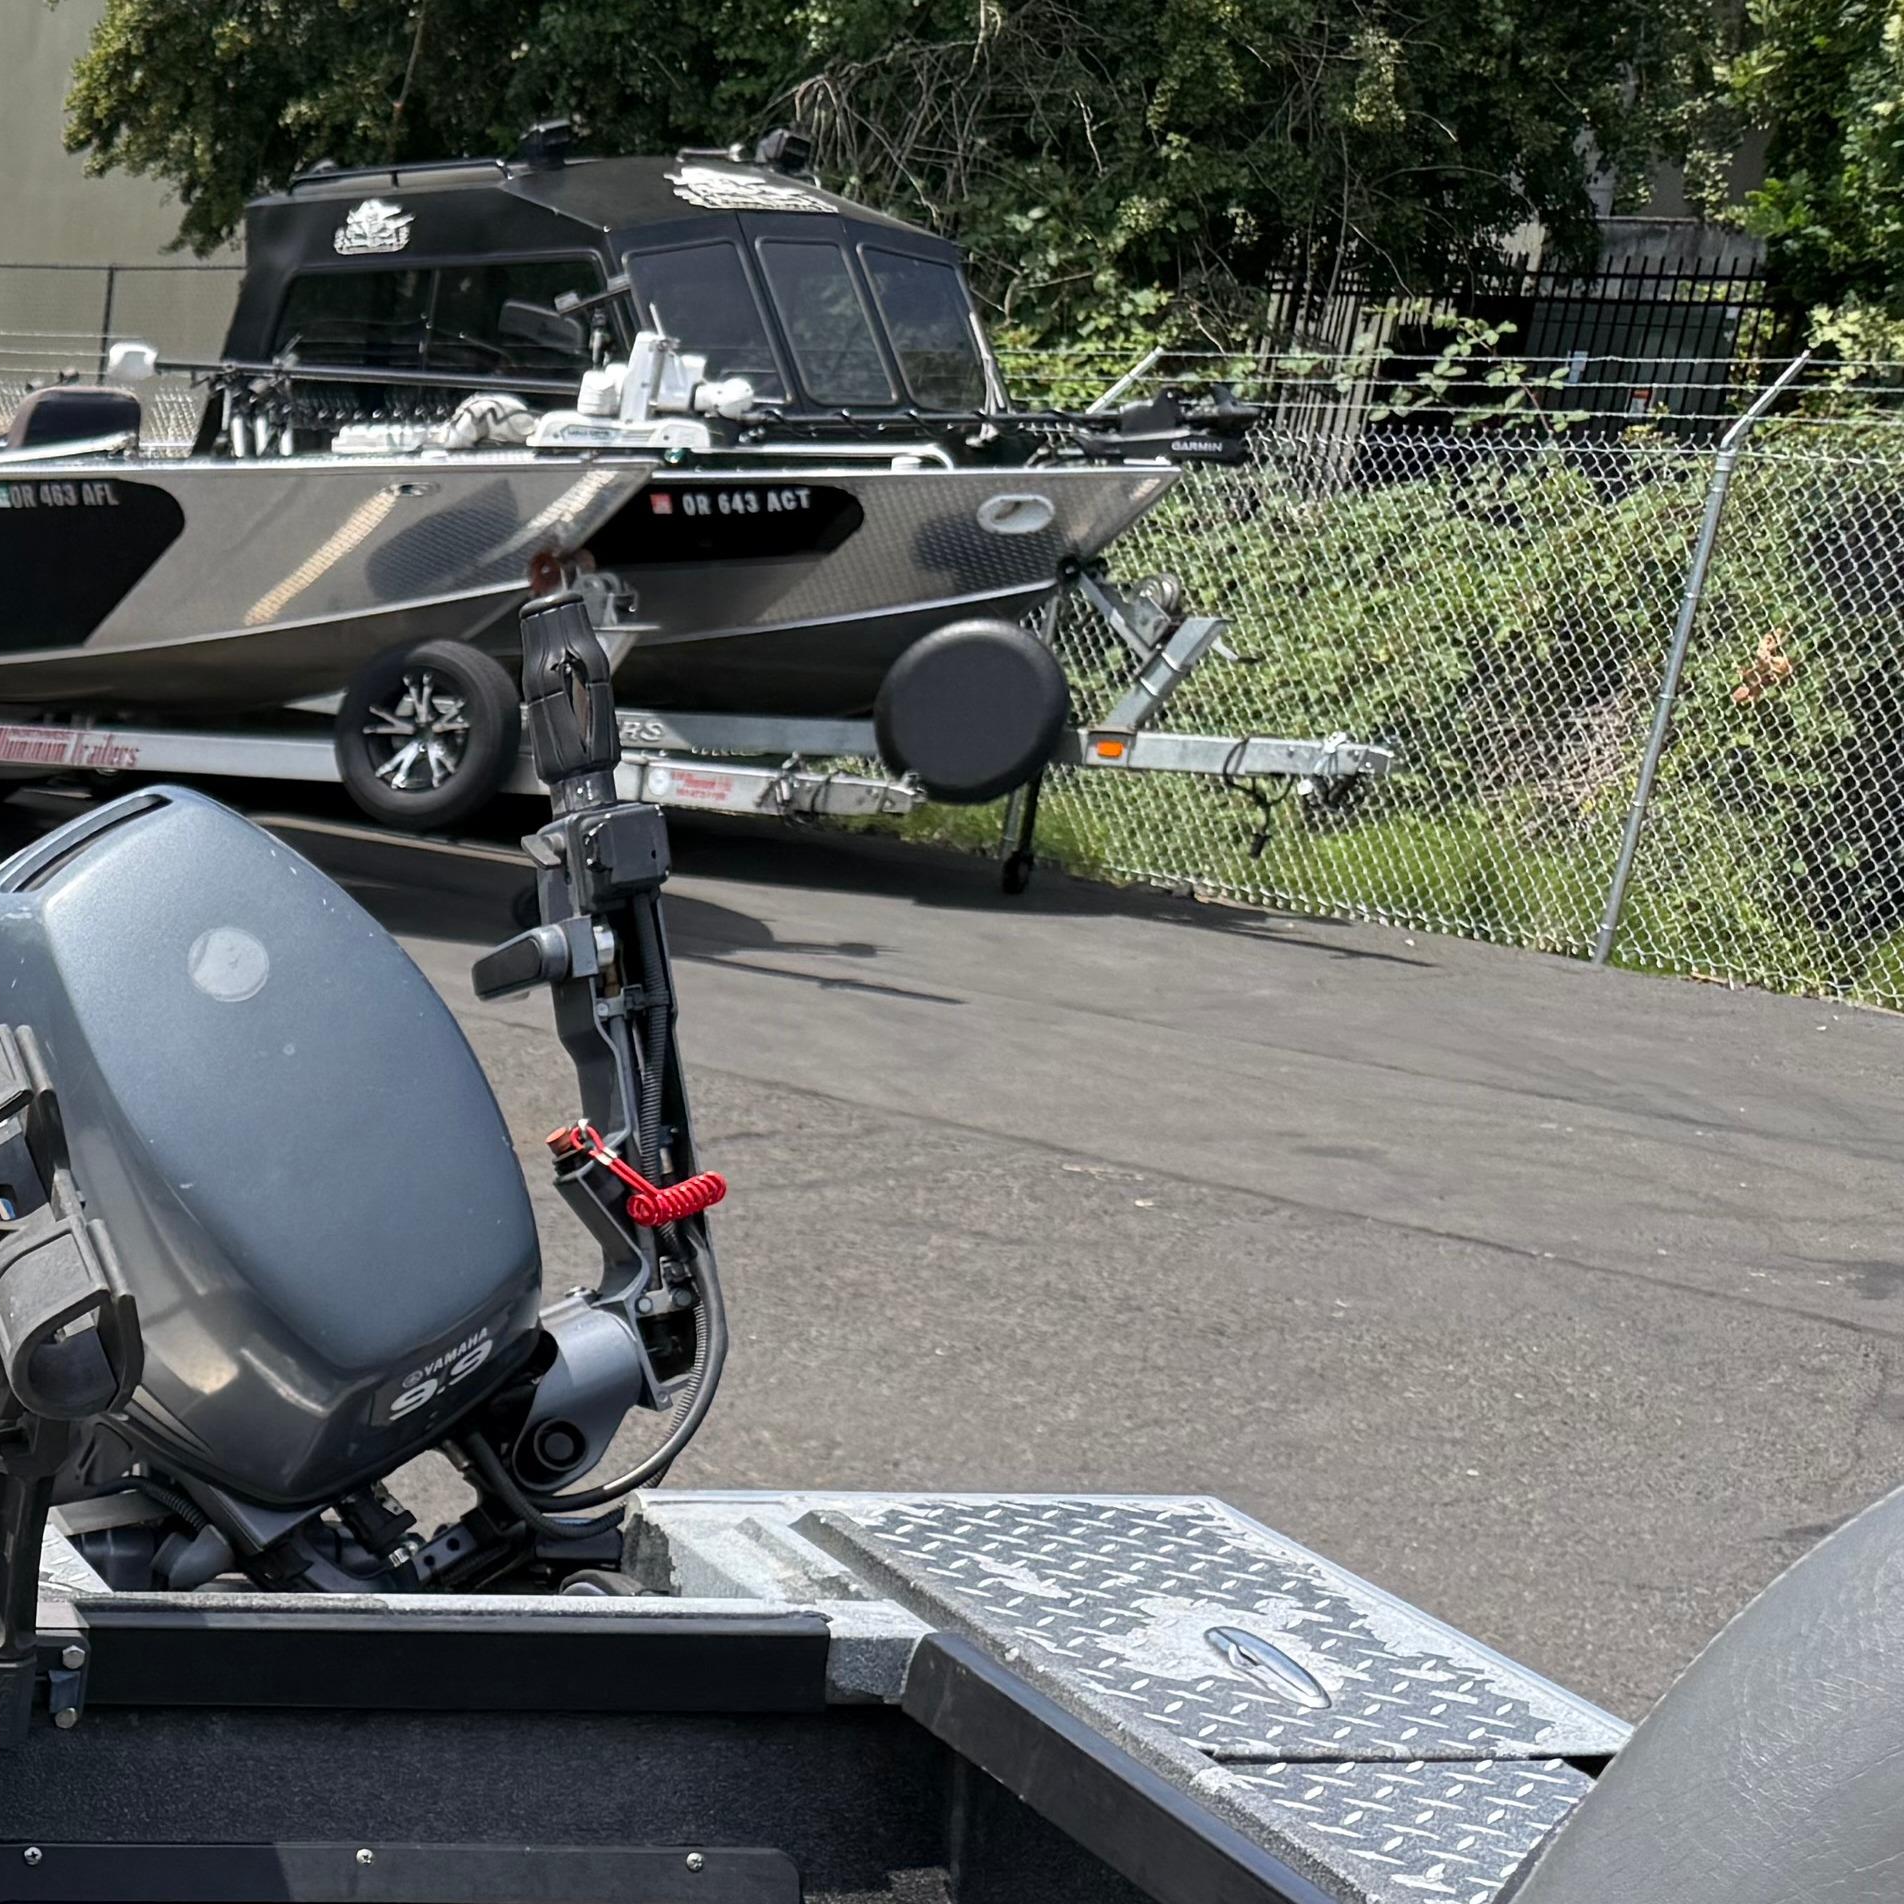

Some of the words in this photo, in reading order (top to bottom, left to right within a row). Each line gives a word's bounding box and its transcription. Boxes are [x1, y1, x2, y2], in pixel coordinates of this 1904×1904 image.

[1171, 441, 1223, 452] GARMIN
[12, 484, 37, 508] OR
[40, 484, 79, 507] 463
[82, 483, 120, 506] AFL
[682, 493, 711, 516] OR
[717, 491, 760, 514] 643
[766, 489, 810, 512] ACT
[423, 1327, 488, 1376] YAMAHA
[389, 1339, 493, 1421] 9.9
